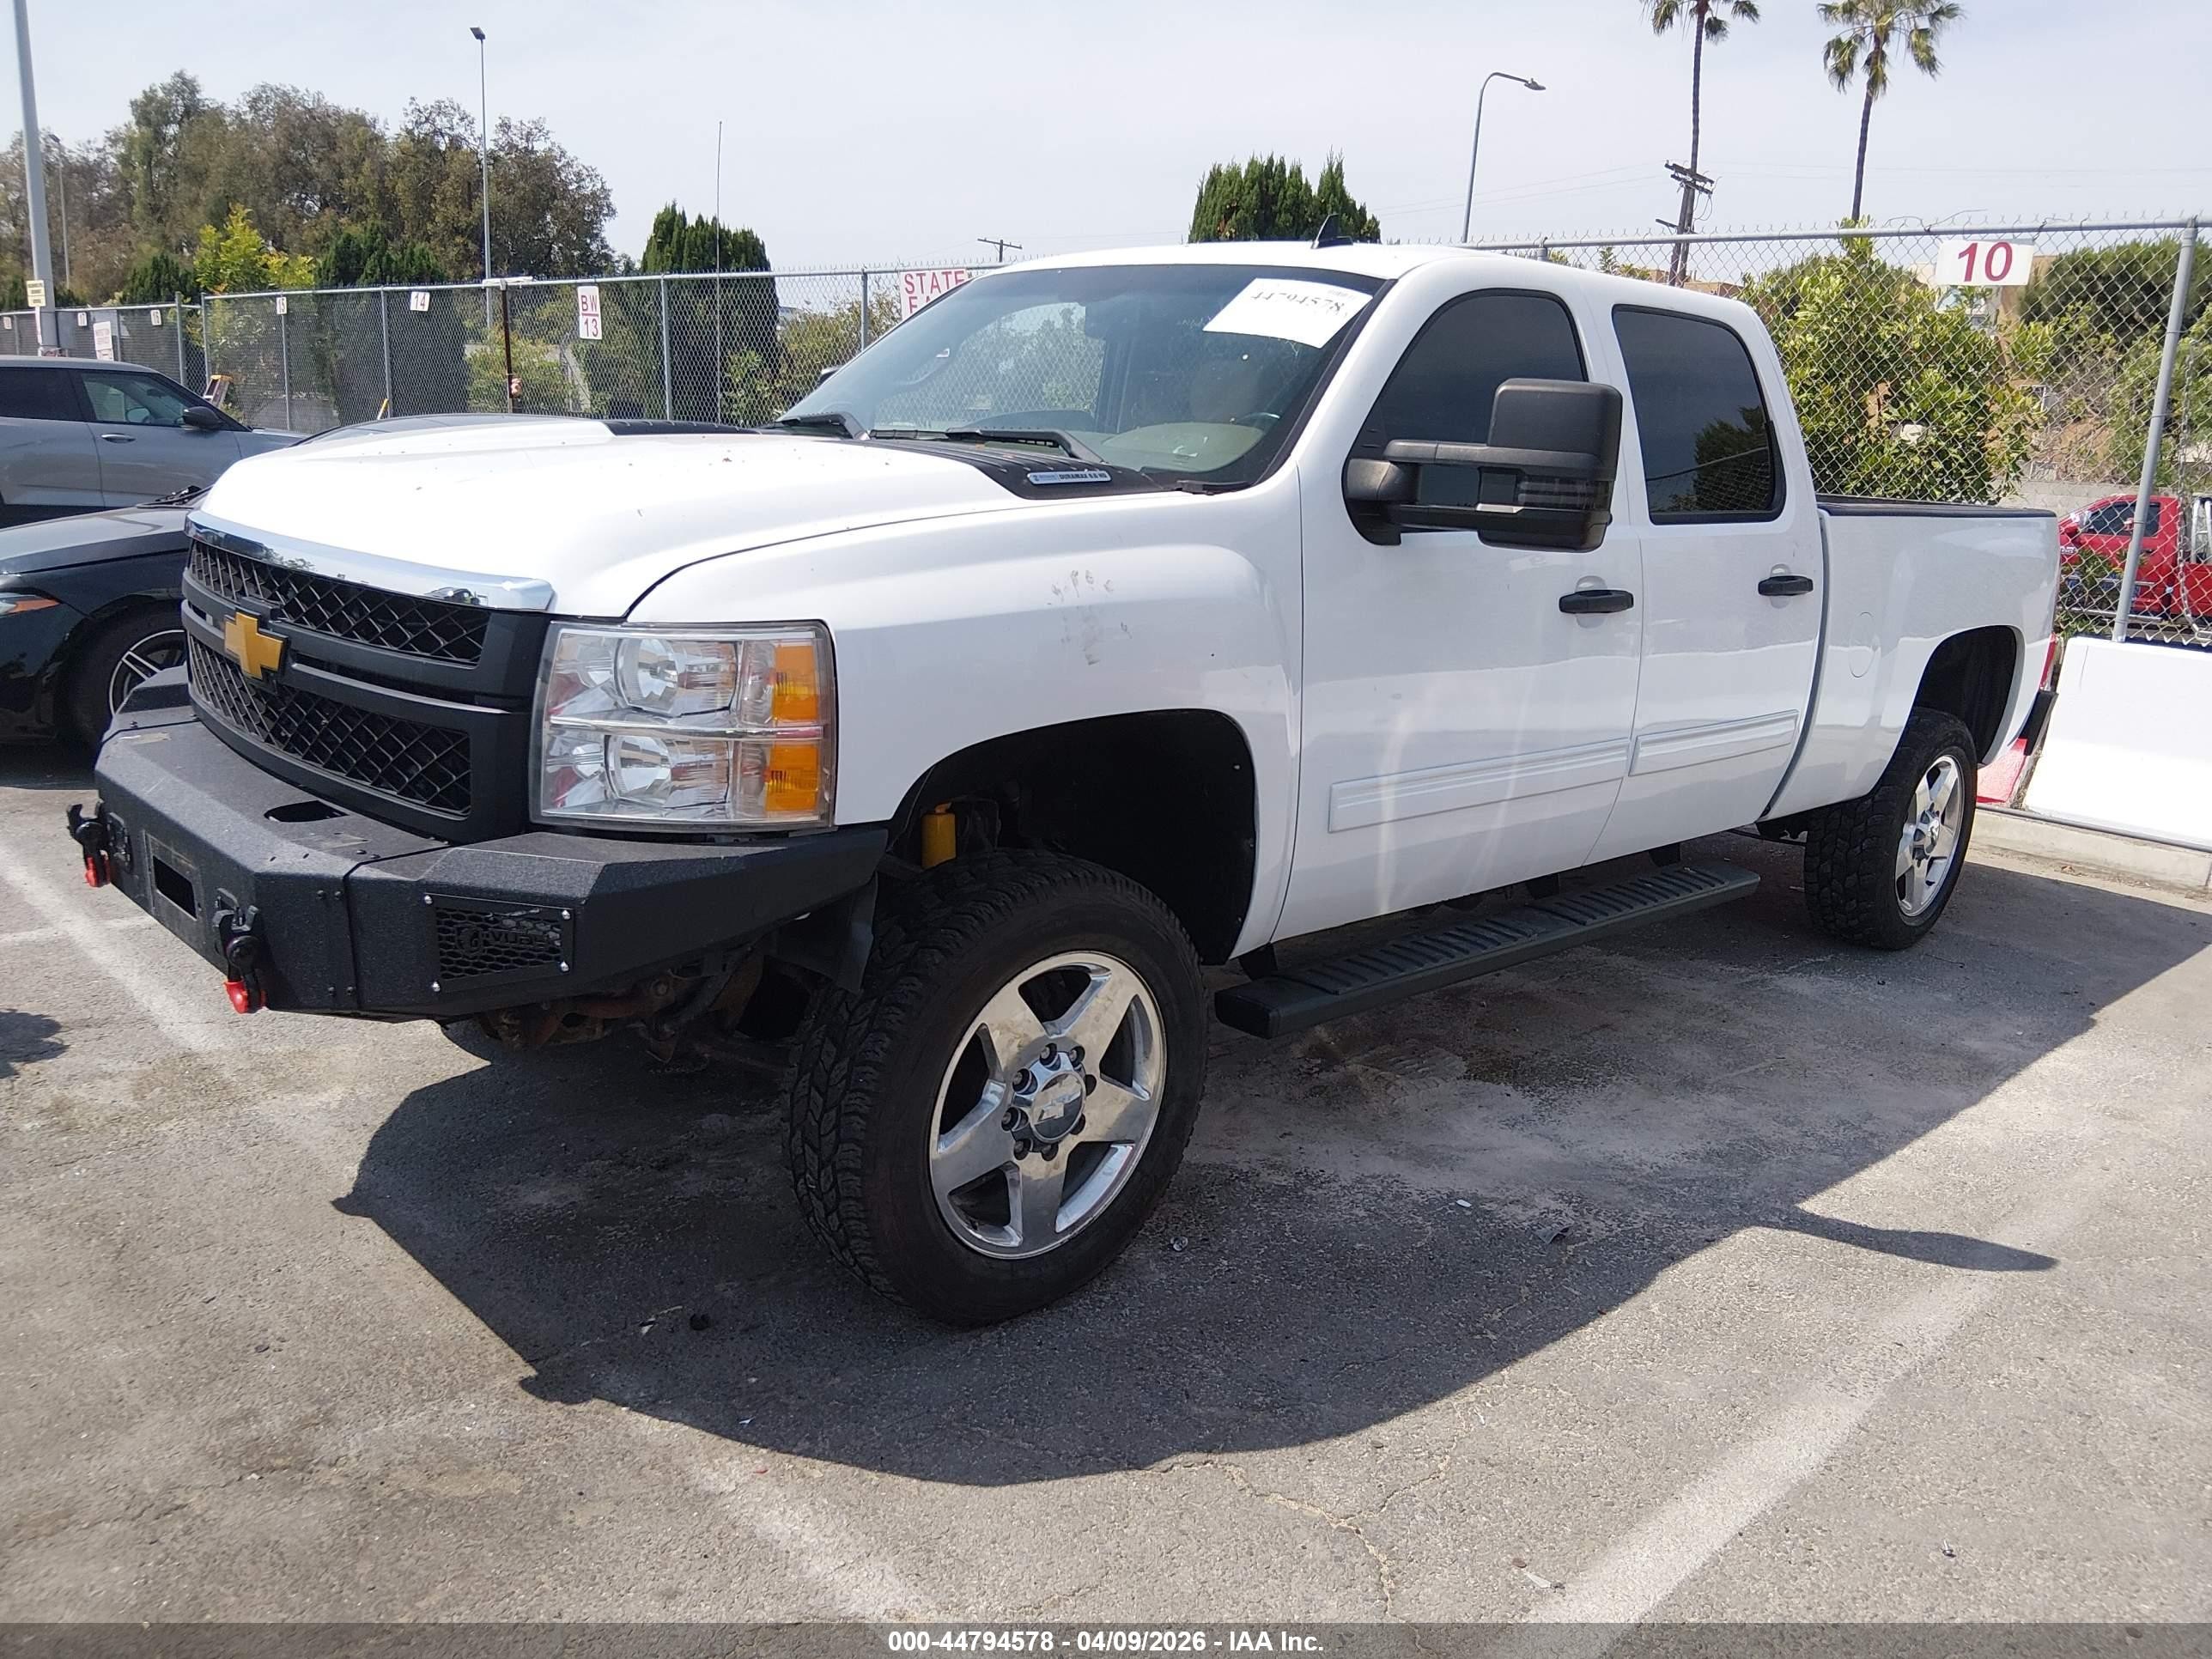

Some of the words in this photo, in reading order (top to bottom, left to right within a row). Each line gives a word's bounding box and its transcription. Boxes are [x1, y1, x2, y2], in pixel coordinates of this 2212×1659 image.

[1958, 241, 2013, 283] 10
[414, 294, 427, 309] 14
[581, 295, 598, 313] BW
[583, 318, 599, 337] 13
